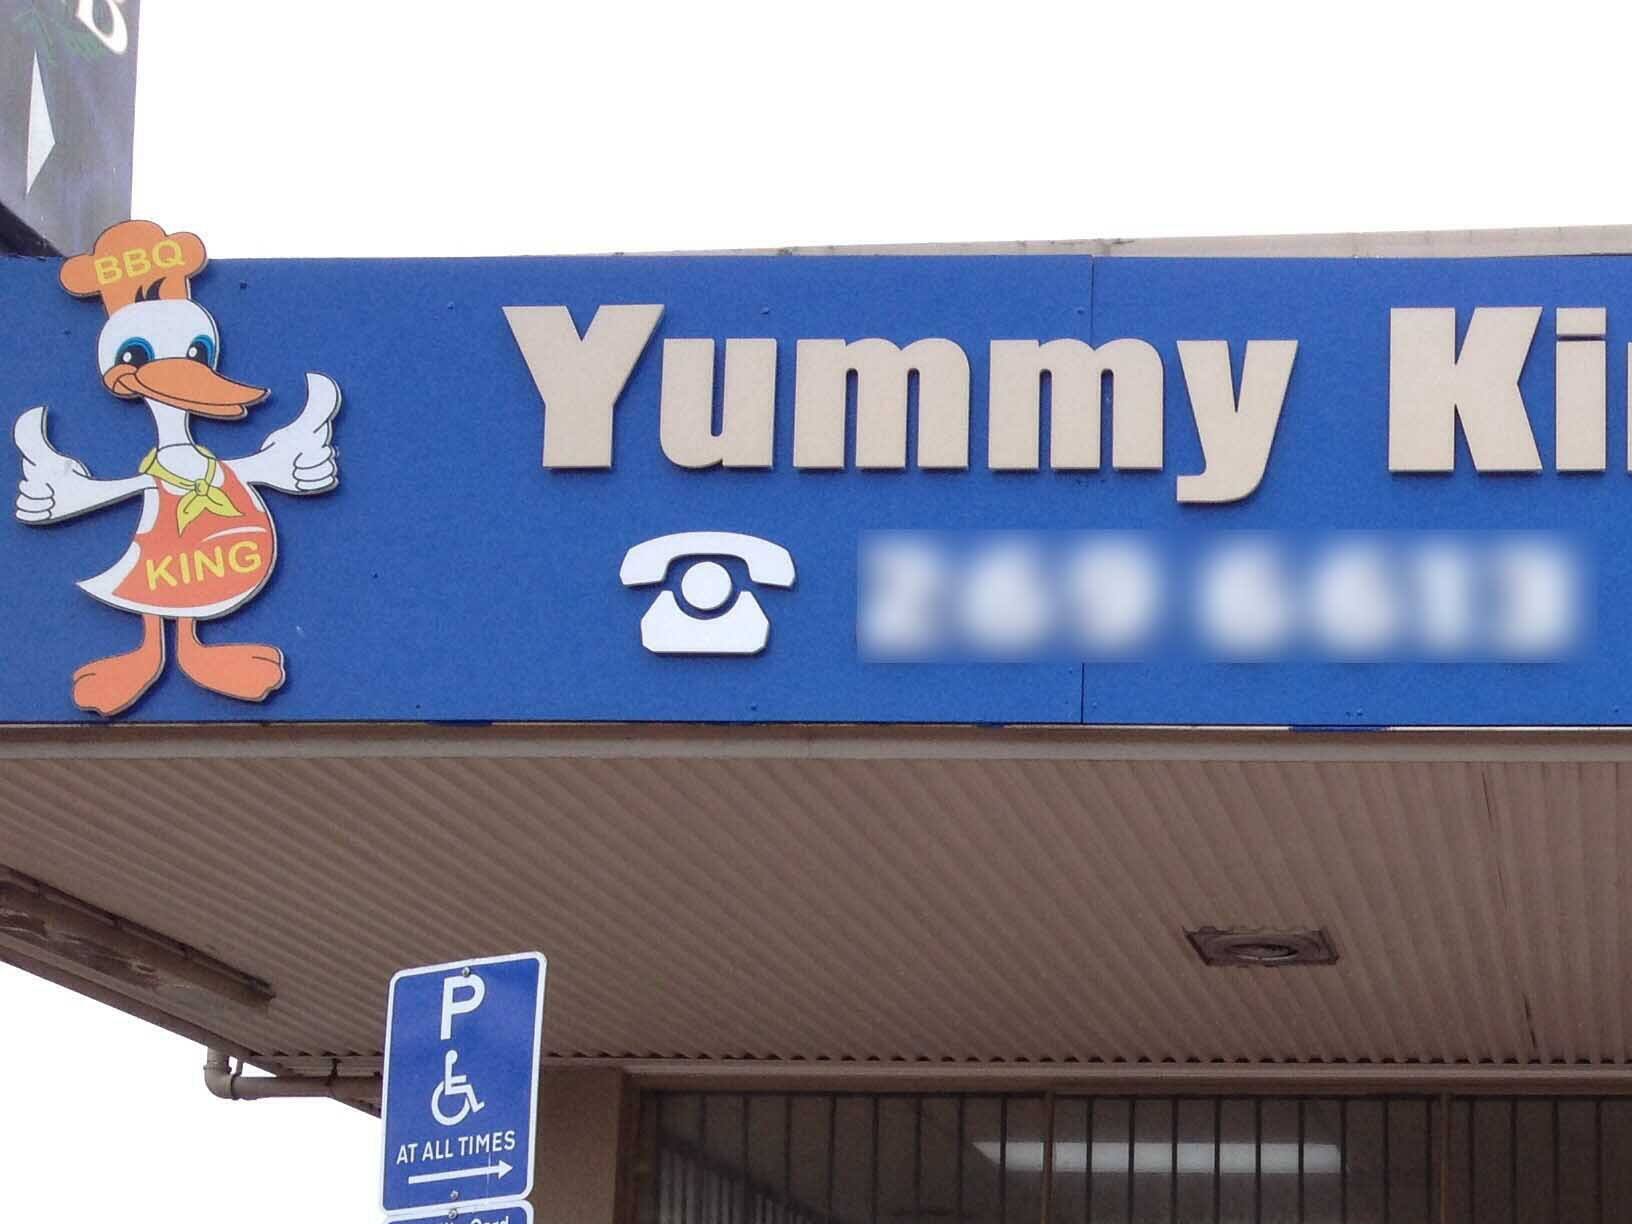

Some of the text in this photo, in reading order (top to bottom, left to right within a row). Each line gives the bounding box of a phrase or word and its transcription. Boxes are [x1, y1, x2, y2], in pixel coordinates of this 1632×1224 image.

[95, 239, 185, 286] BBQ
[502, 304, 1299, 504] Yummy
[145, 540, 263, 590] KING
[440, 974, 485, 1040] P
[396, 1130, 516, 1165] AT ALL TIMES
